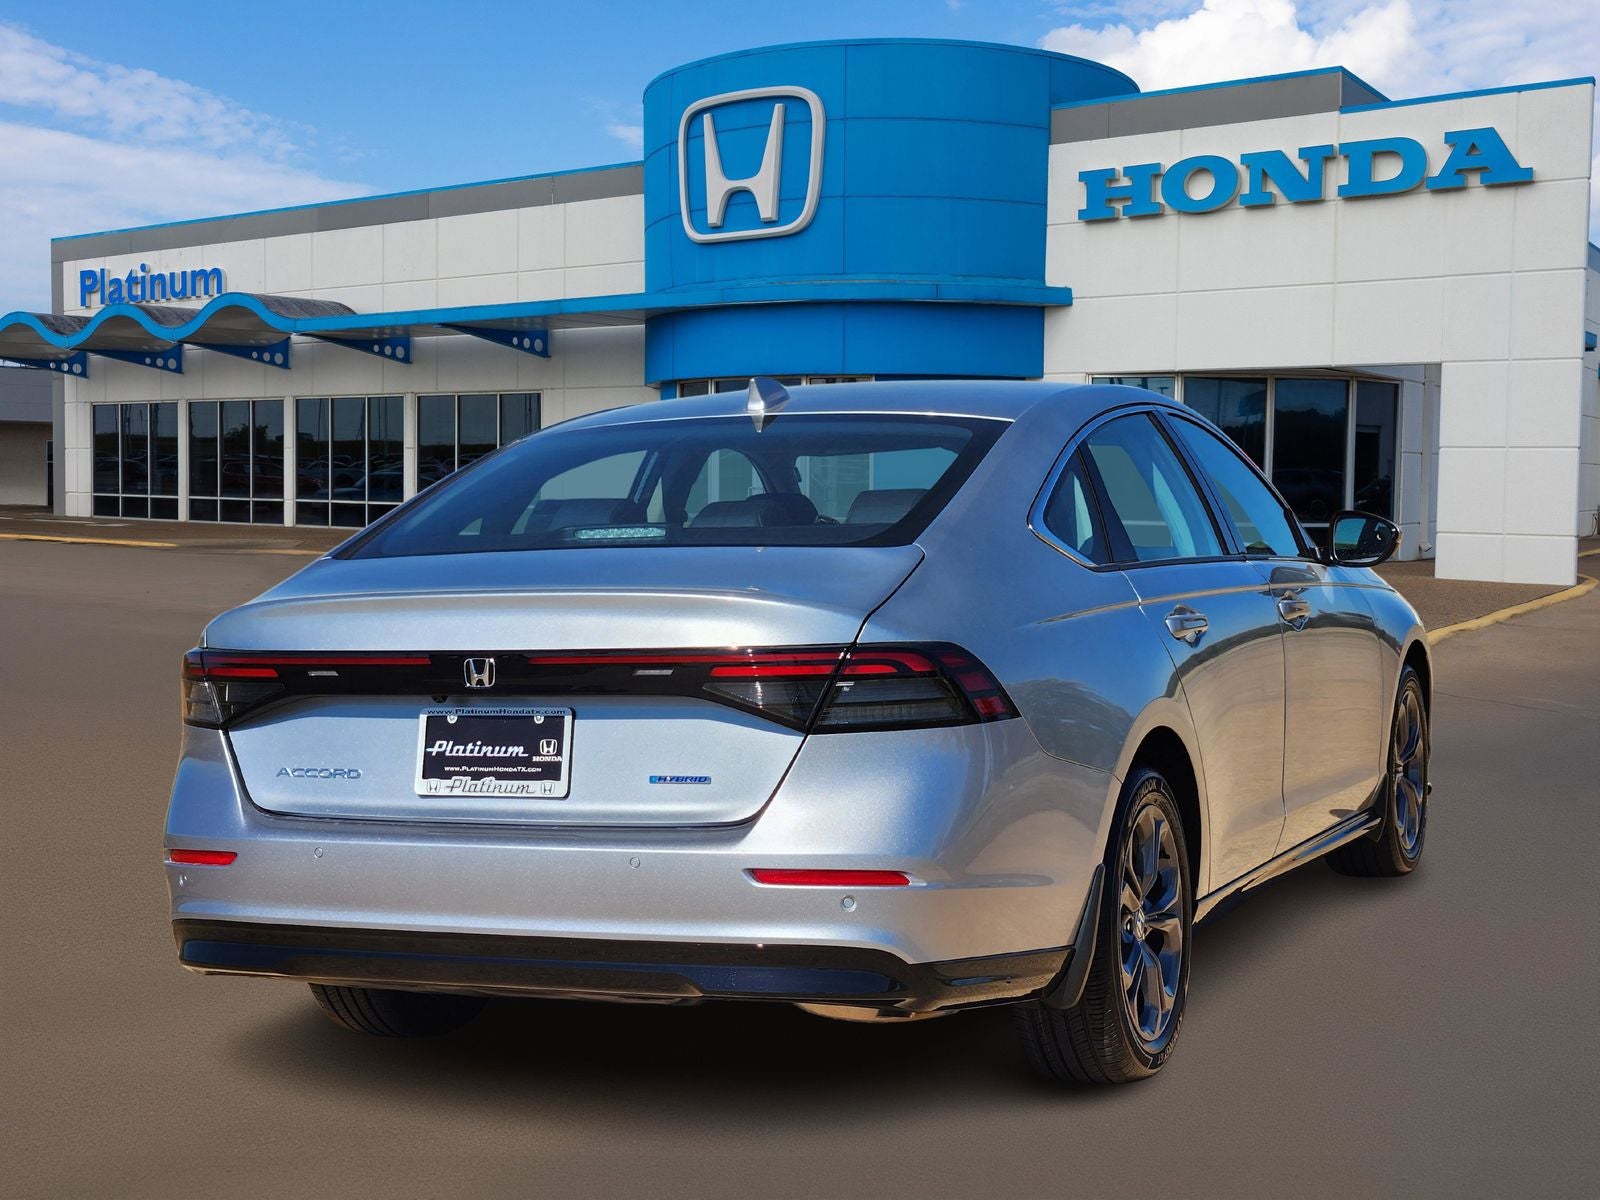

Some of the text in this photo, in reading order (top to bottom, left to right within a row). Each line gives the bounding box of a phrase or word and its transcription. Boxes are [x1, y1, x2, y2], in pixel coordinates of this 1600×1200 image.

[1078, 126, 1534, 222] HONDA
[80, 263, 226, 307] Platinum
[426, 740, 529, 757] Platinum
[276, 767, 363, 779] ACCORD
[444, 777, 537, 794] Platinum
